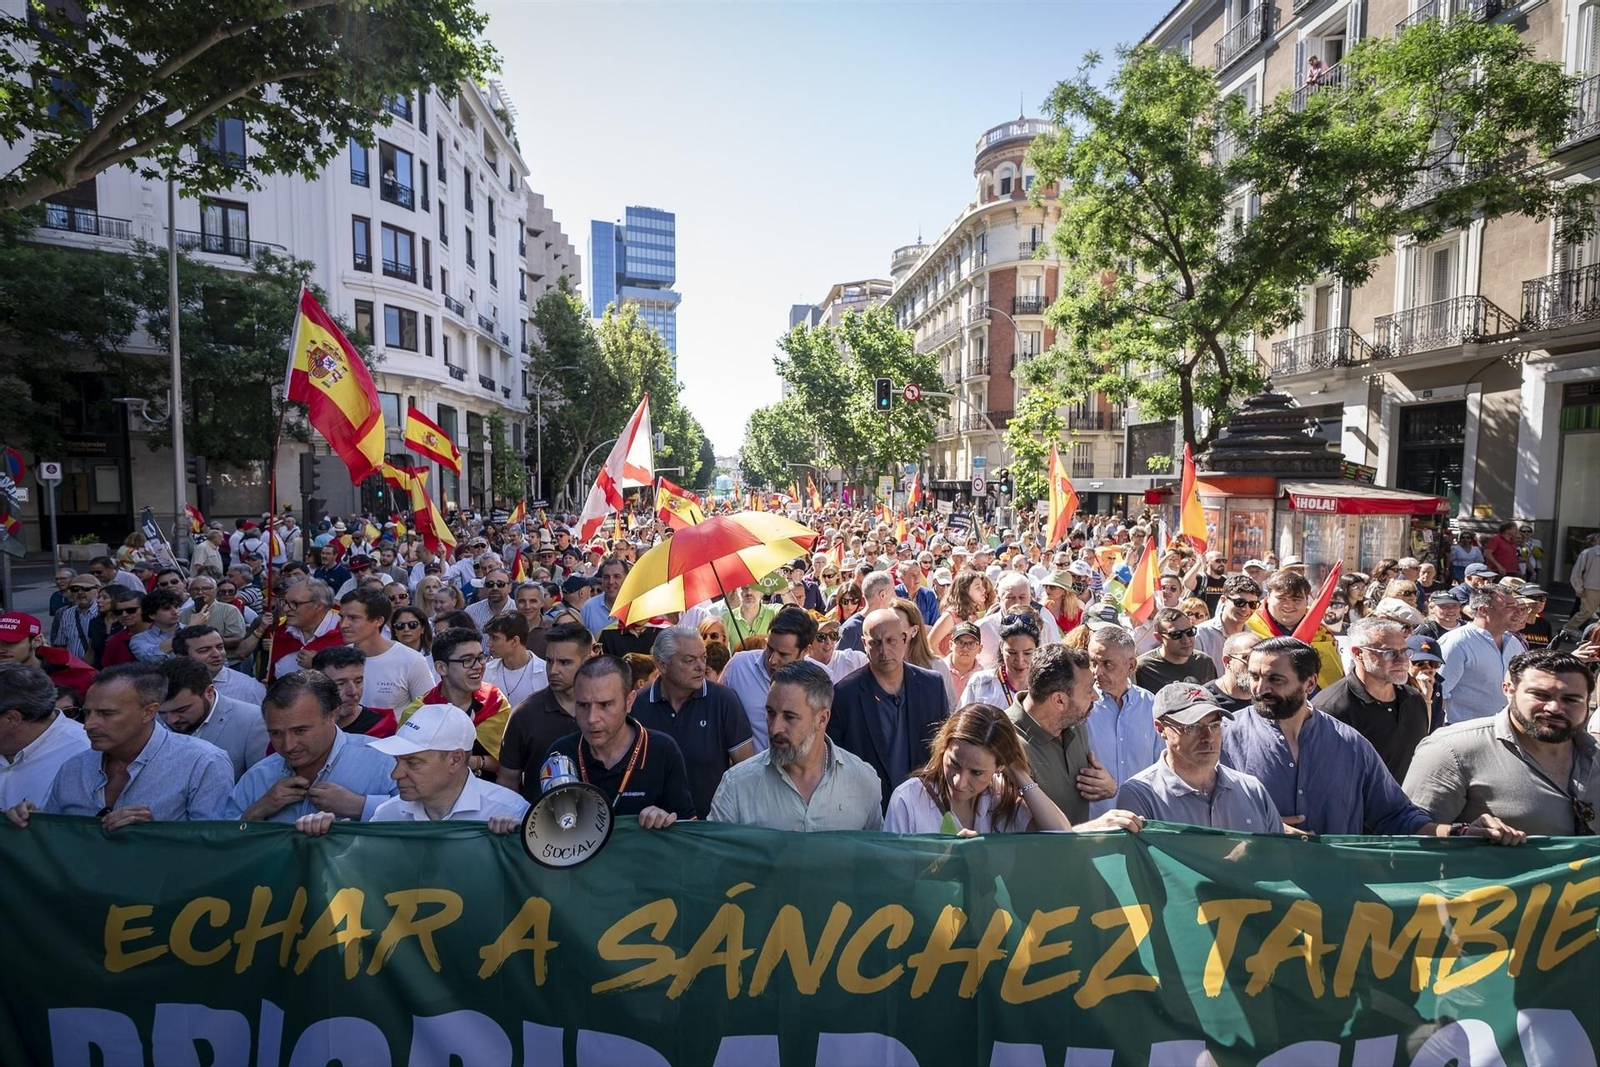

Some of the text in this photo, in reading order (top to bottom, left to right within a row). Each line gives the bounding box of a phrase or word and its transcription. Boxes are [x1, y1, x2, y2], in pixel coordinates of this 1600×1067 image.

[1296, 497, 1335, 511] ¡HOLA!
[759, 577, 779, 588] VOX
[104, 885, 464, 981] ECHAR
[477, 896, 561, 987] A
[591, 882, 1163, 1009] SÁNCHEZ
